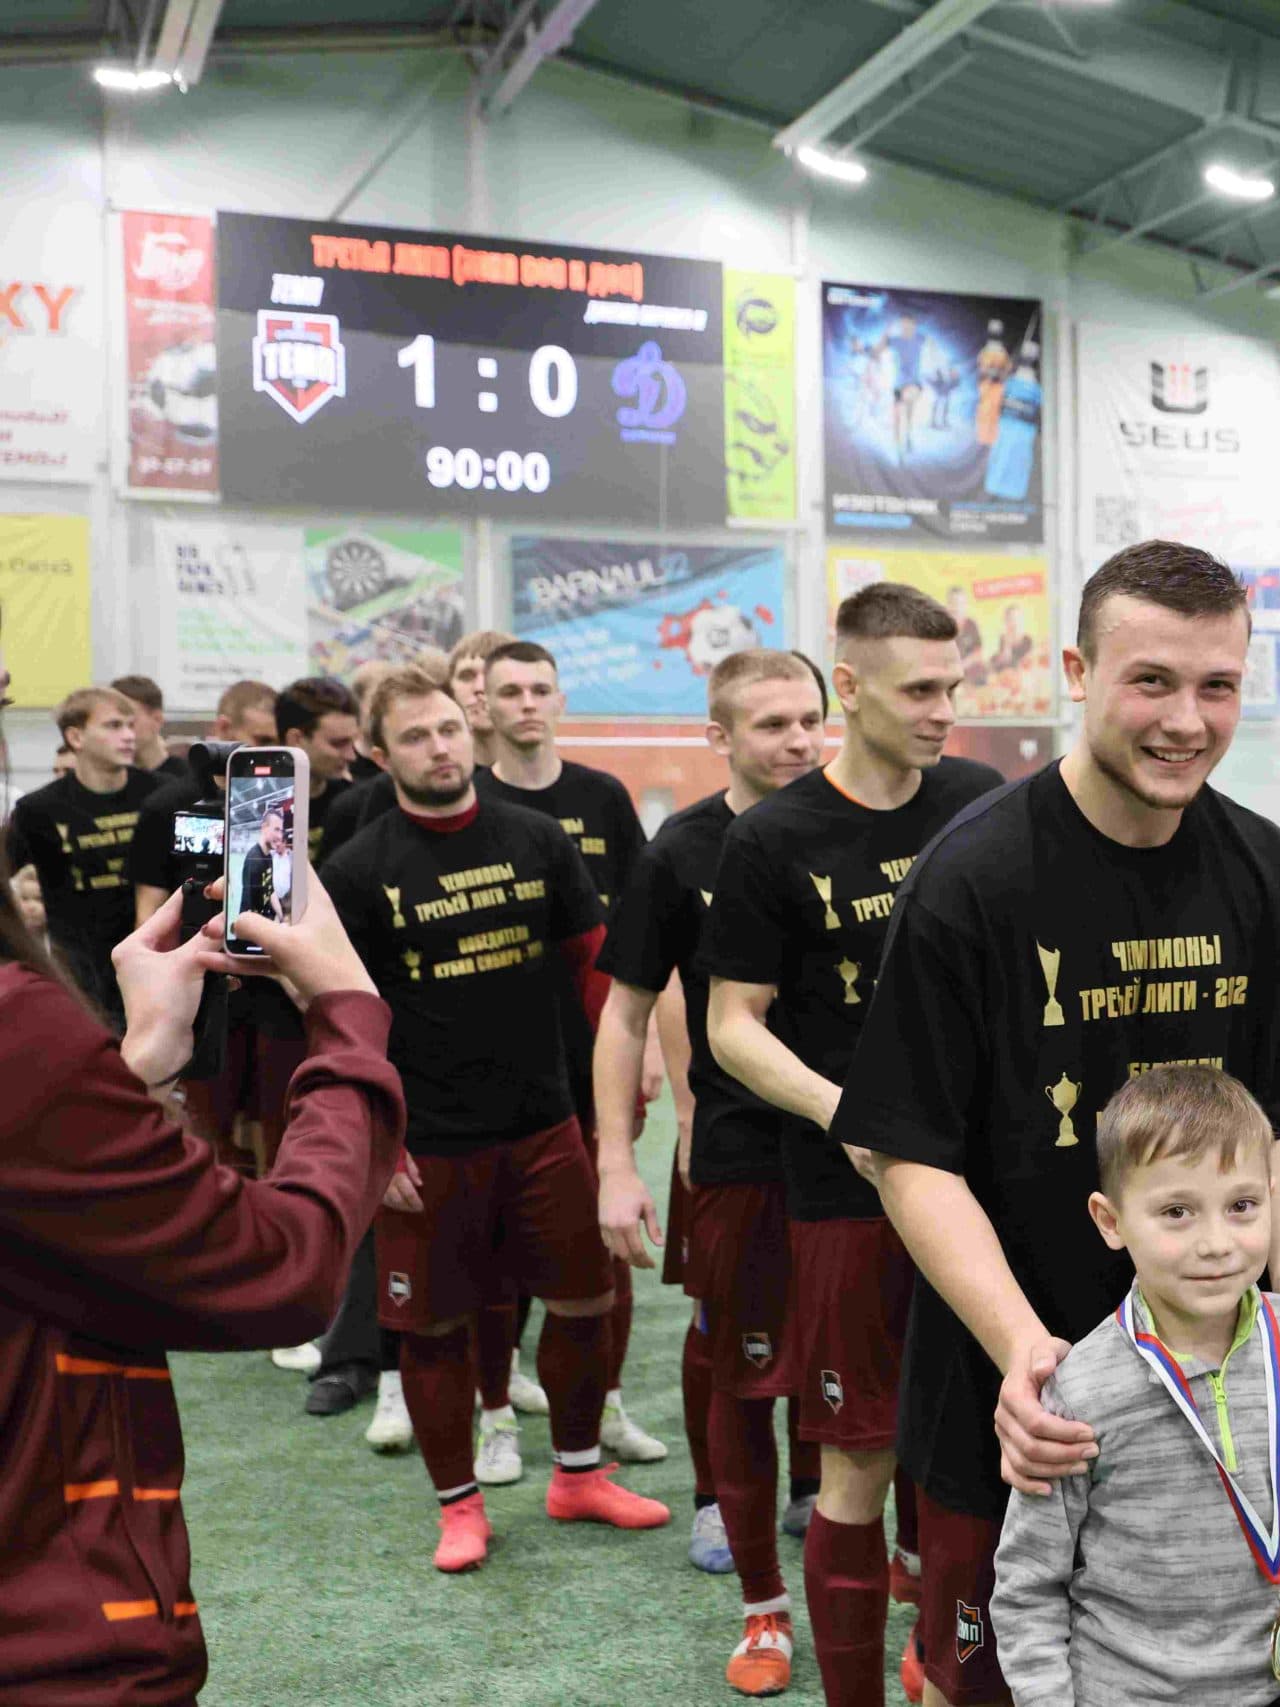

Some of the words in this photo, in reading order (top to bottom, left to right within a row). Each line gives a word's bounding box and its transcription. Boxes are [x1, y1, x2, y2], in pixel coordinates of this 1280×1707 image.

[397, 334, 435, 408] 1
[528, 344, 578, 417] 0
[1120, 420, 1241, 454] SEUS
[426, 445, 550, 492] 90:00
[880, 855, 918, 883] ЧЕМ
[1142, 980, 1197, 1014] ЛИГИ
